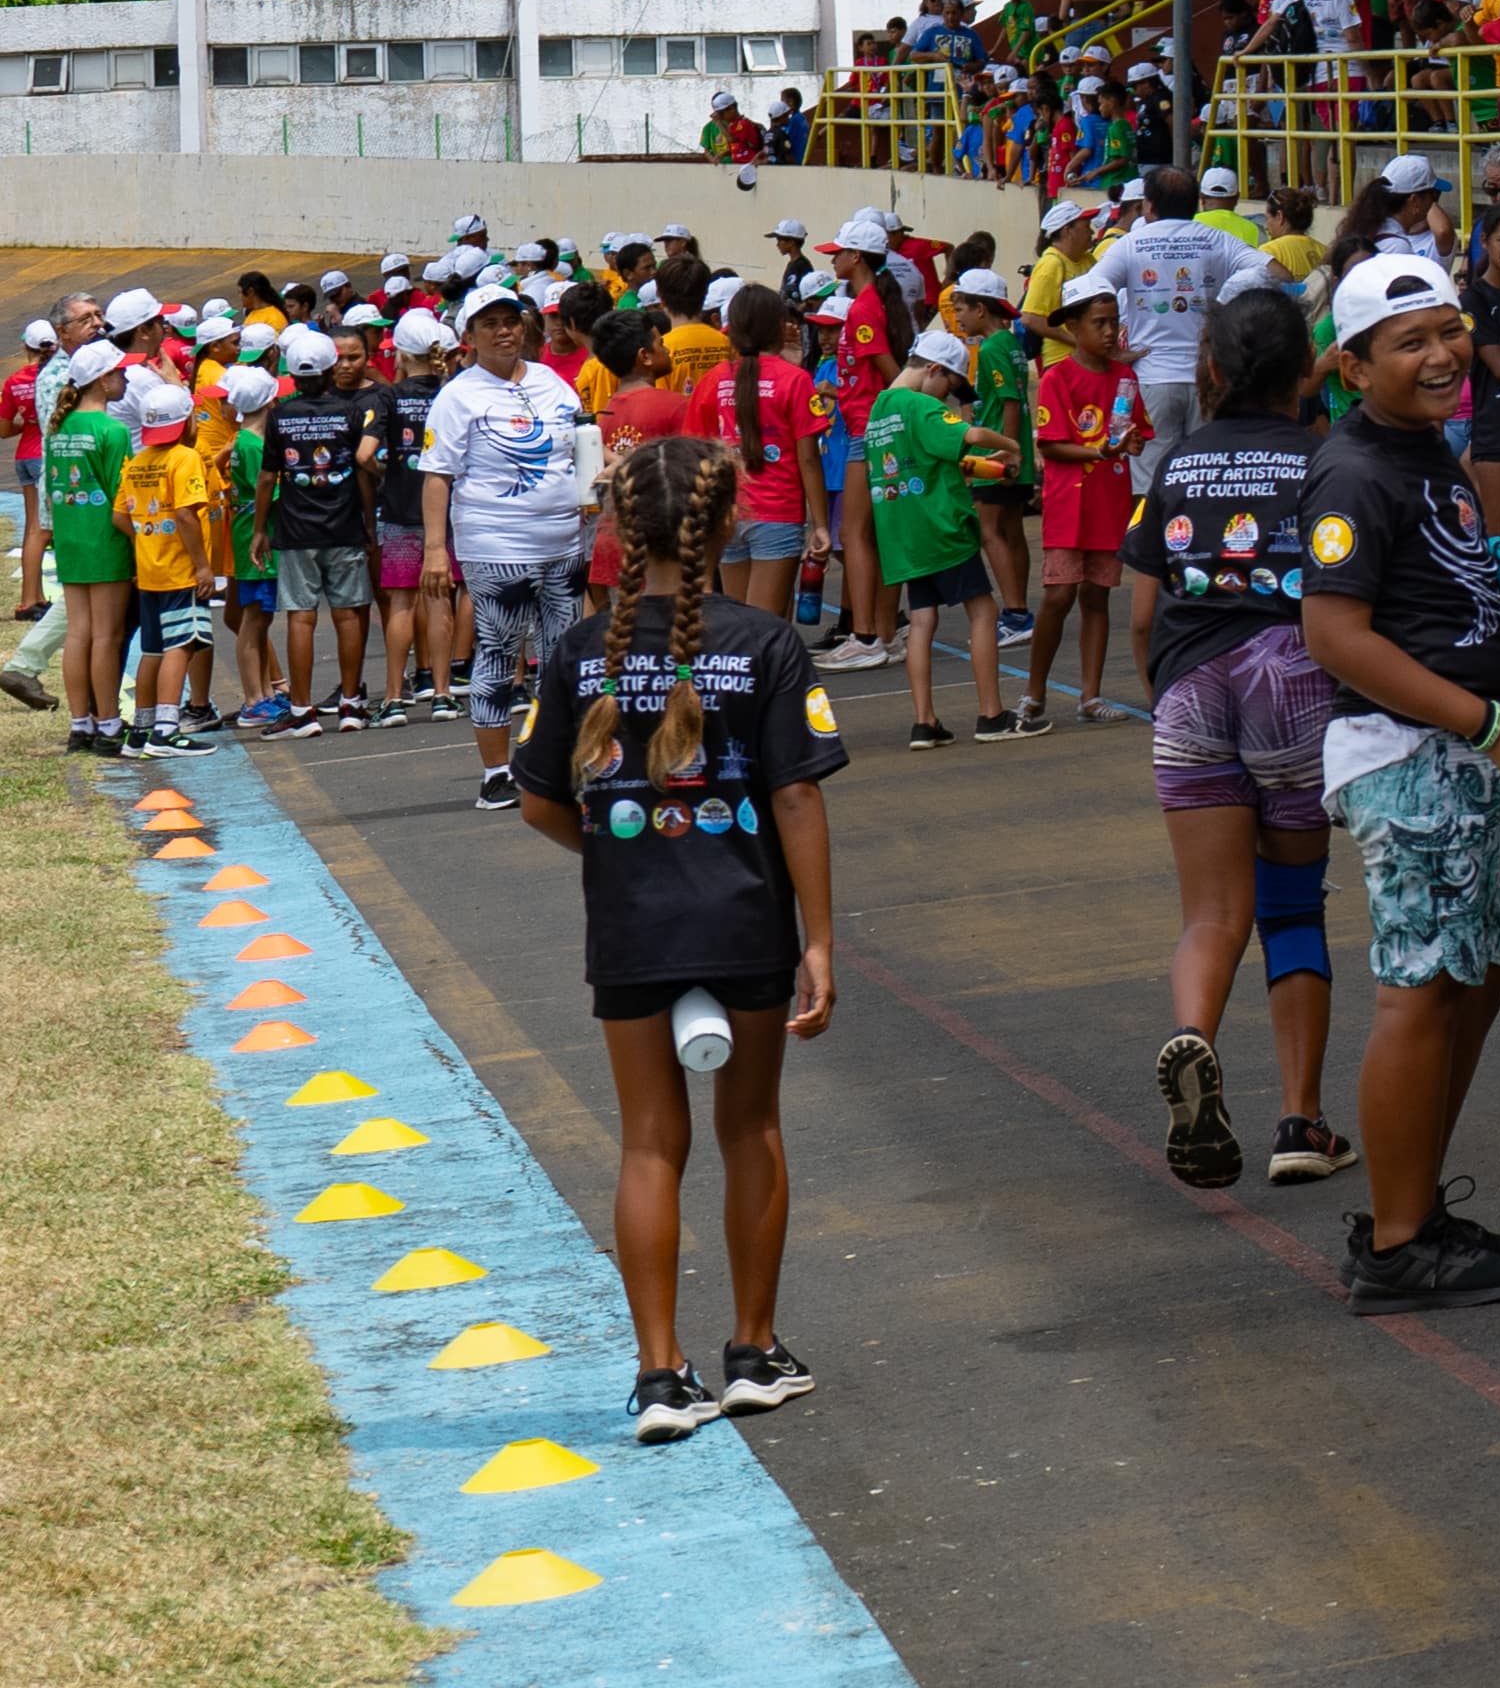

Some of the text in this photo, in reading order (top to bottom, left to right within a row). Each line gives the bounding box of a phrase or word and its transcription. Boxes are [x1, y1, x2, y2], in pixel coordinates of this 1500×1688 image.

[1169, 451, 1309, 471] FESTIVAL SCOLAIRE
[1164, 468, 1221, 487] SPORTIF
[1186, 482, 1278, 499] ET CULTUREL
[580, 654, 752, 678] FESVAL SLAIRE
[577, 674, 755, 697] SPOTIF ARSTIQUE
[635, 694, 720, 712] CULEL
